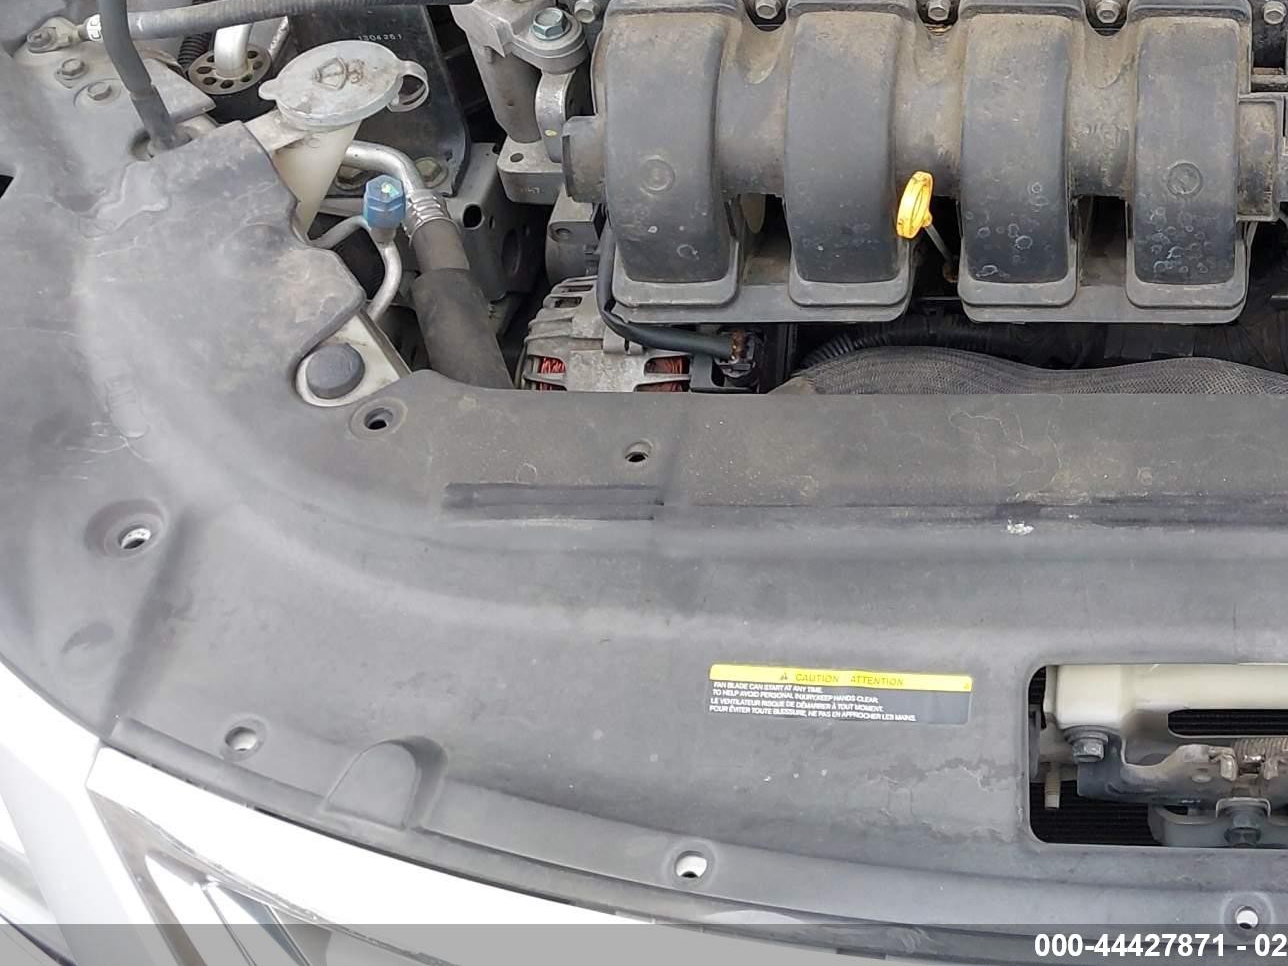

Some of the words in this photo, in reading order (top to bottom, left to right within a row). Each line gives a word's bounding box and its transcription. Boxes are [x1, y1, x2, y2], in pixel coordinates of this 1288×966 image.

[795, 673, 839, 683] CAUTION
[850, 675, 904, 686] ATTENTION
[720, 698, 760, 706] VENTILATEUR
